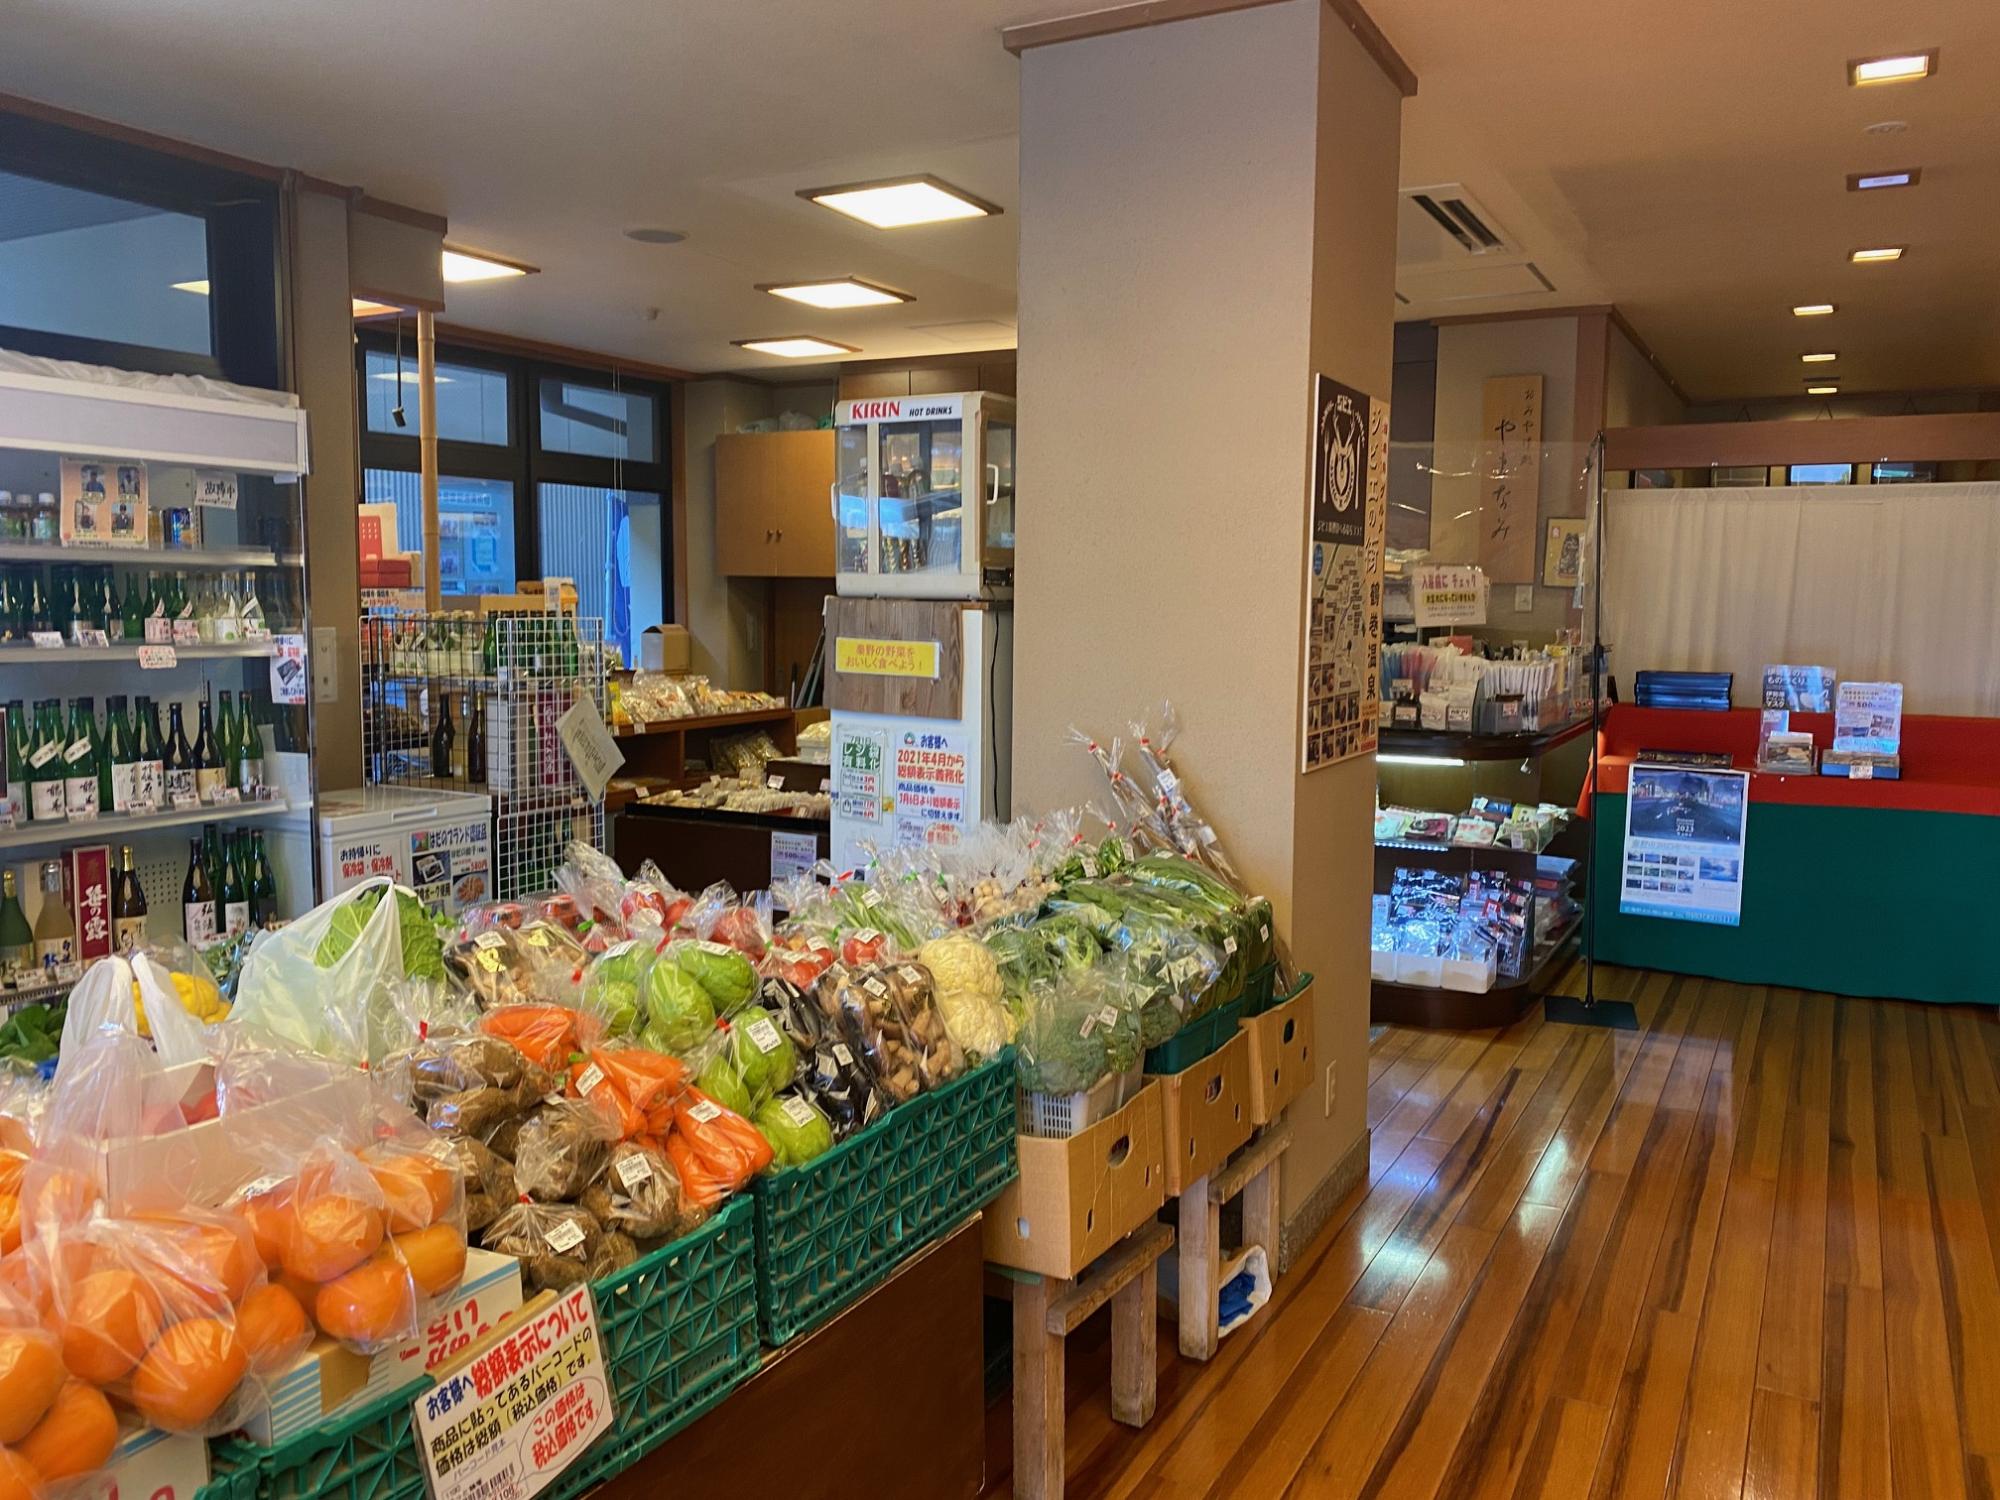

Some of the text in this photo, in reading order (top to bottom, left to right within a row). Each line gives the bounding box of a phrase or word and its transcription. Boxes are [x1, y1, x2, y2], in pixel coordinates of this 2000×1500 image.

[852, 401, 900, 419] KIRIN
[909, 406, 952, 417] HOT DRINKS
[856, 644, 914, 658] 秦野の野菜を
[897, 750, 965, 768] 2021年4月から
[897, 765, 965, 784] 総額表示義務化
[426, 1375, 475, 1422] お客様へ
[471, 1290, 589, 1399] 総額表示について
[430, 1326, 592, 1458] 商品に貼ってあるバーコードの
[533, 1382, 586, 1436] この価格は
[434, 1356, 592, 1478] 価格は総額（税込価格）です。
[531, 1399, 599, 1470] 税込価格です。
